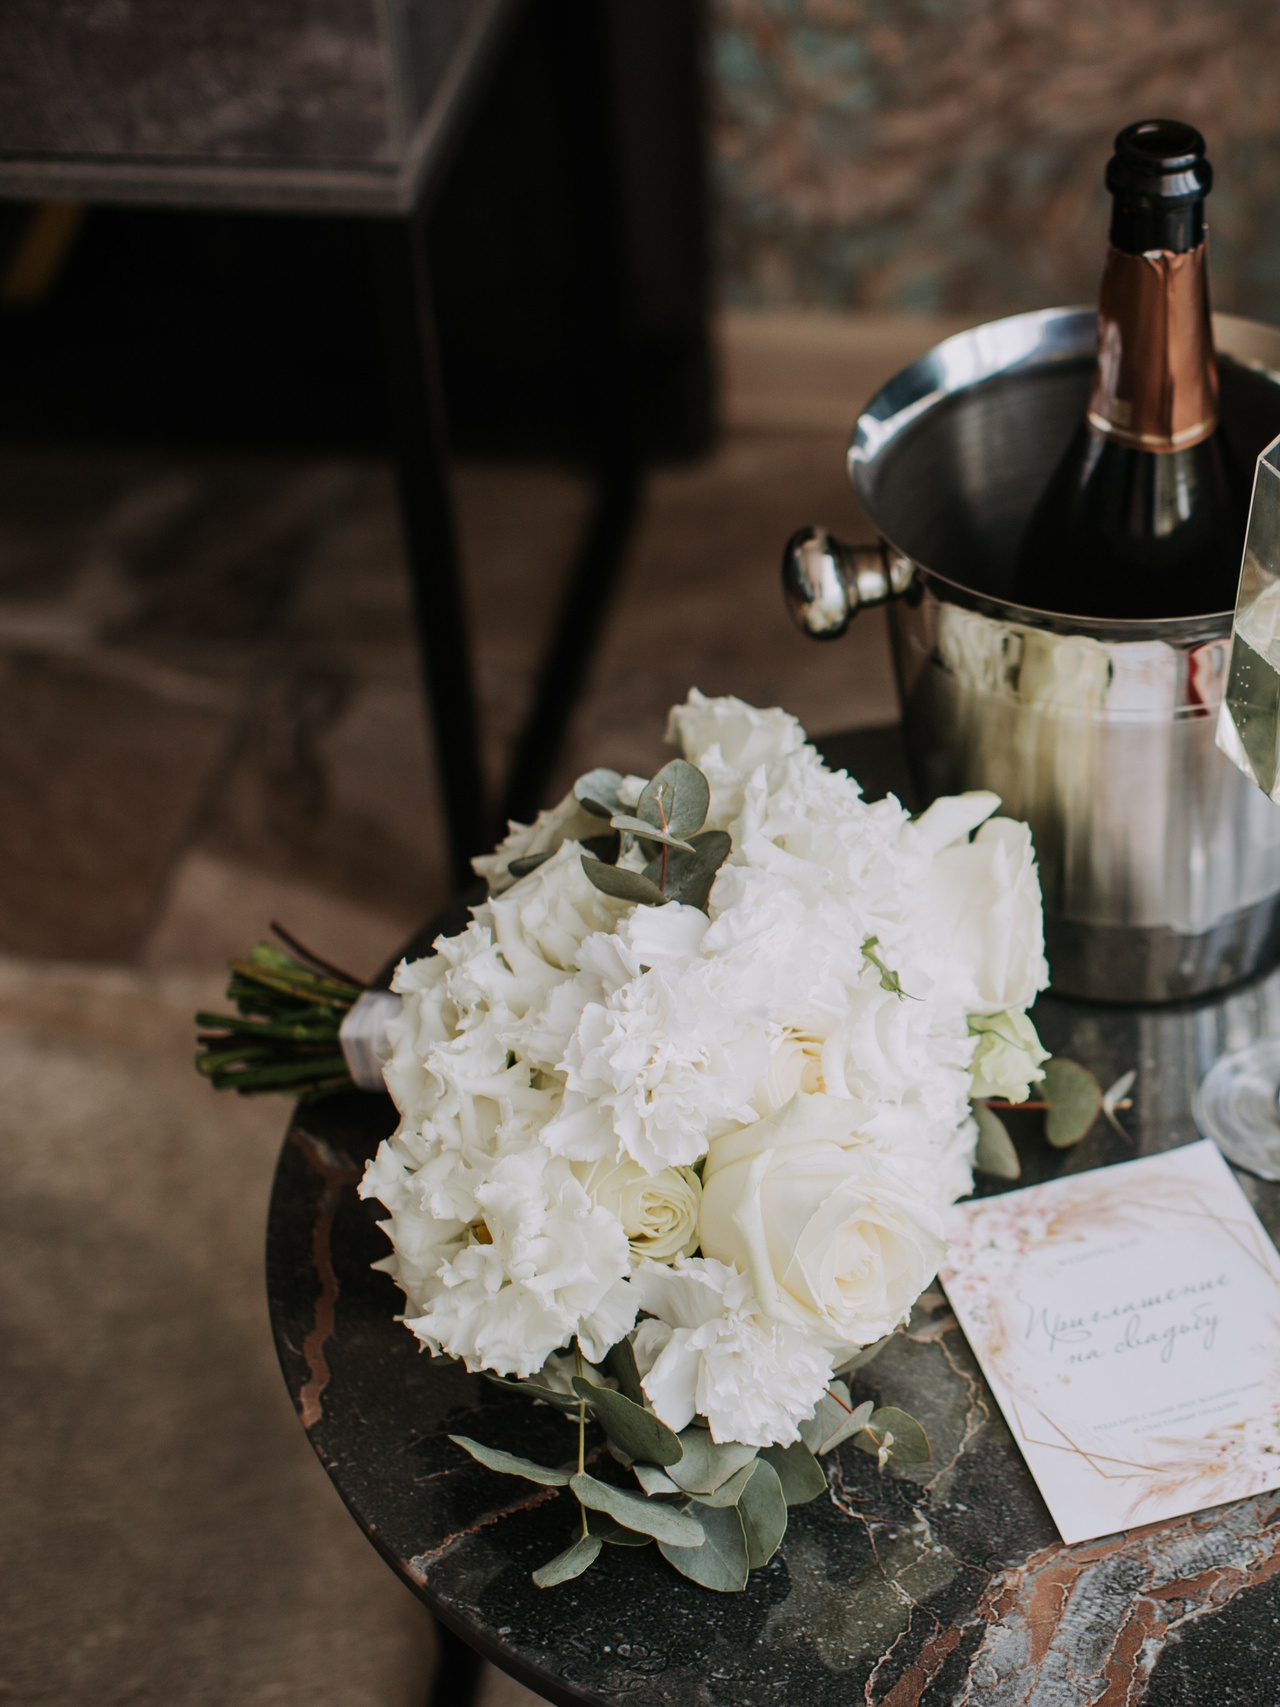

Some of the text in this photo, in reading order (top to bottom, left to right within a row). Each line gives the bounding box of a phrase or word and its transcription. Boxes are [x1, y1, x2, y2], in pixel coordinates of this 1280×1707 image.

[1016, 1273, 1231, 1352] Приглашение
[1066, 1301, 1222, 1364] на свадьбу
